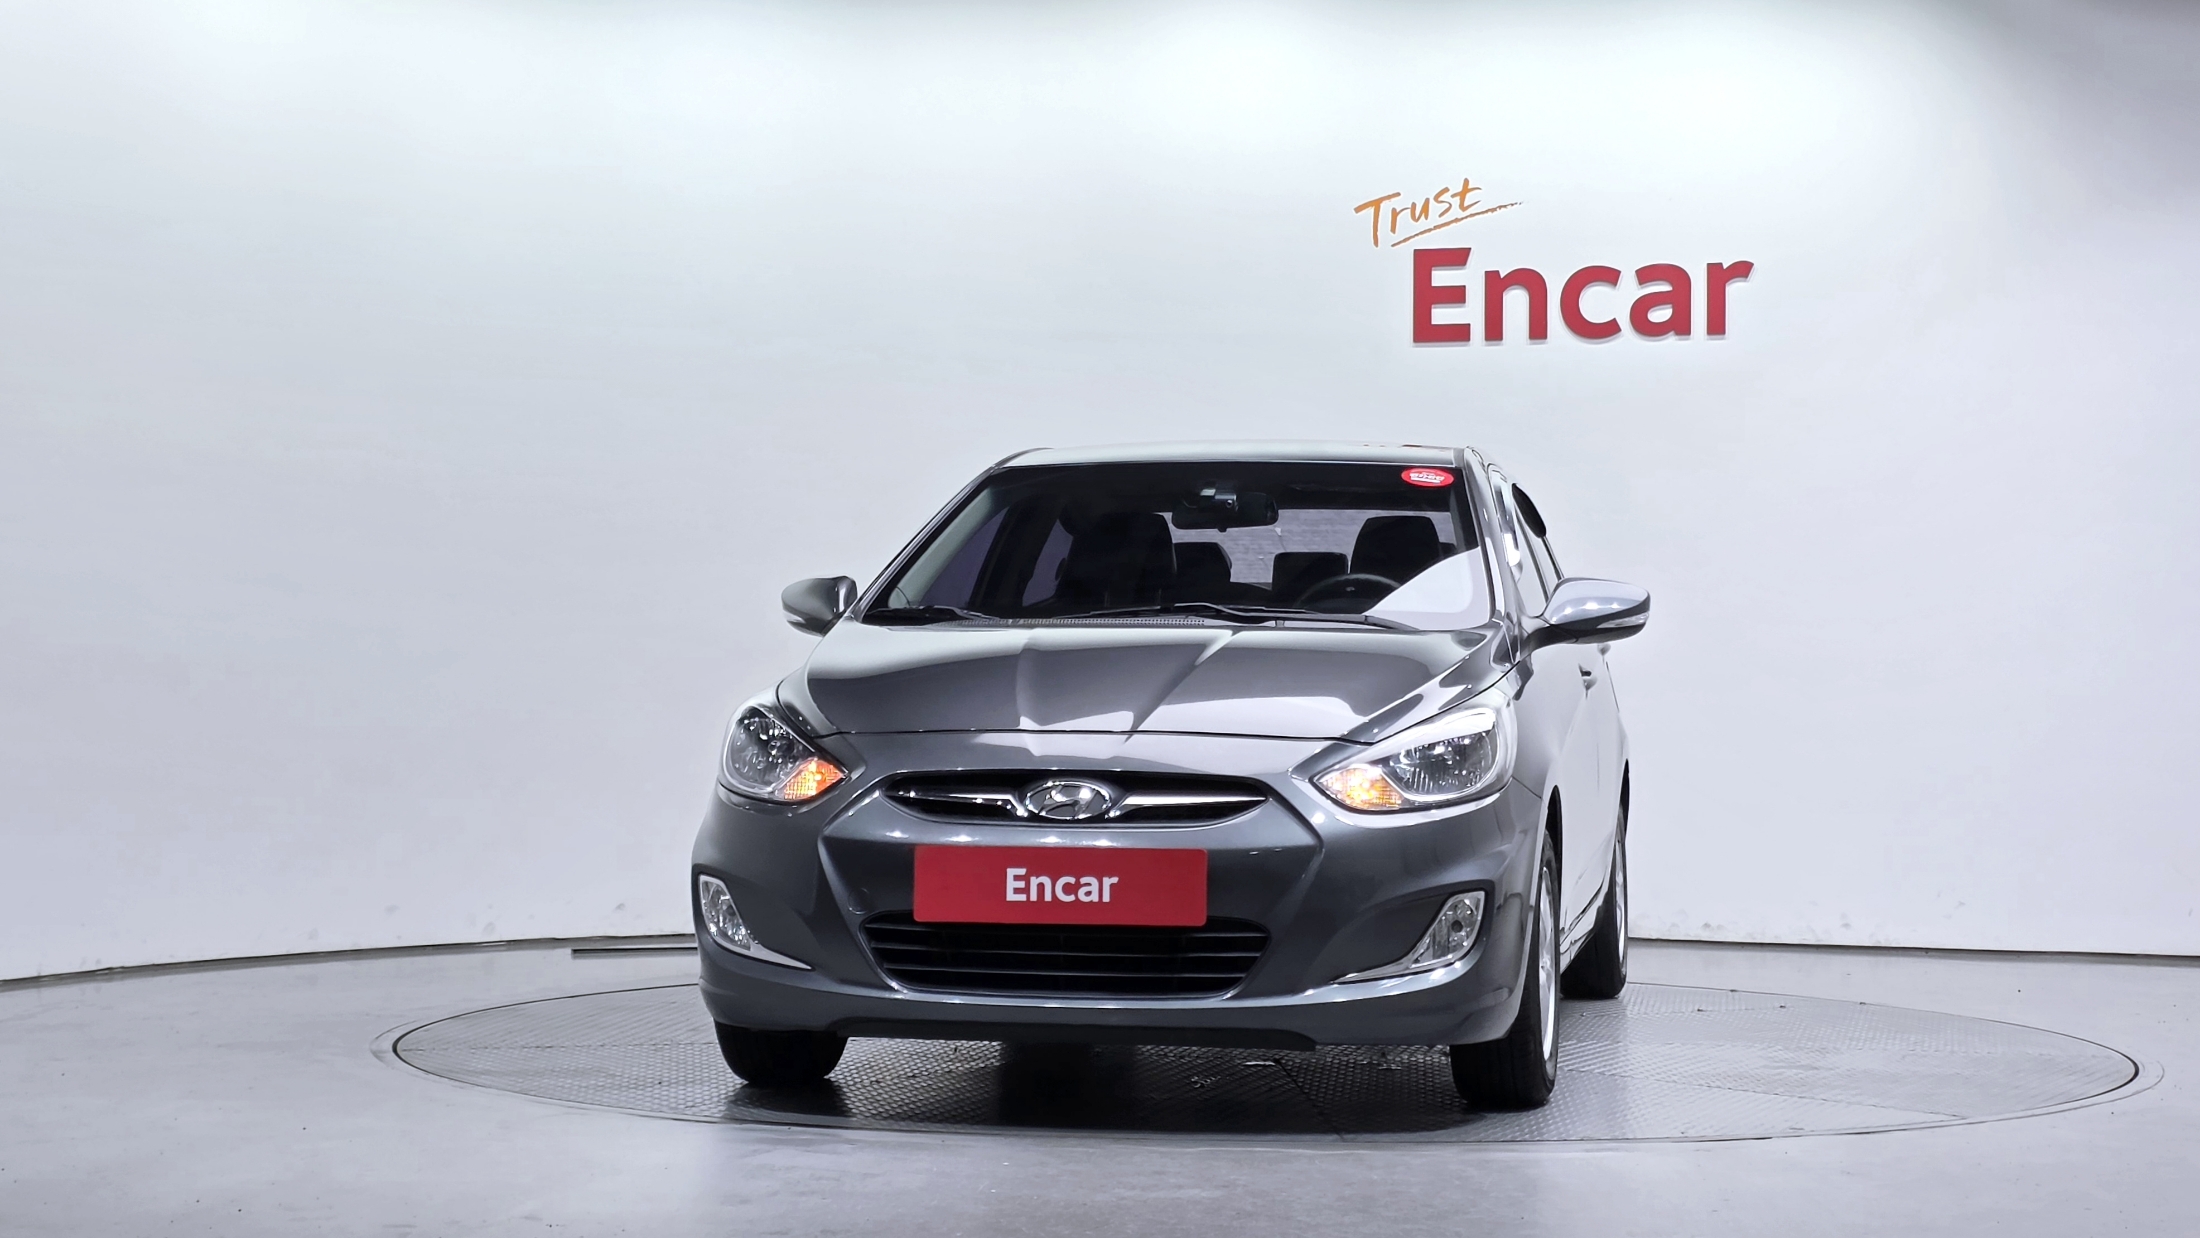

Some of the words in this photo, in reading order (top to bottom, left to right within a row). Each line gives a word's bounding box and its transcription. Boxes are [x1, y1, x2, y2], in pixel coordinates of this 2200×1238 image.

[1354, 178, 1482, 247] Trust
[1413, 247, 1755, 344] Encar
[1006, 867, 1119, 903] Encar
